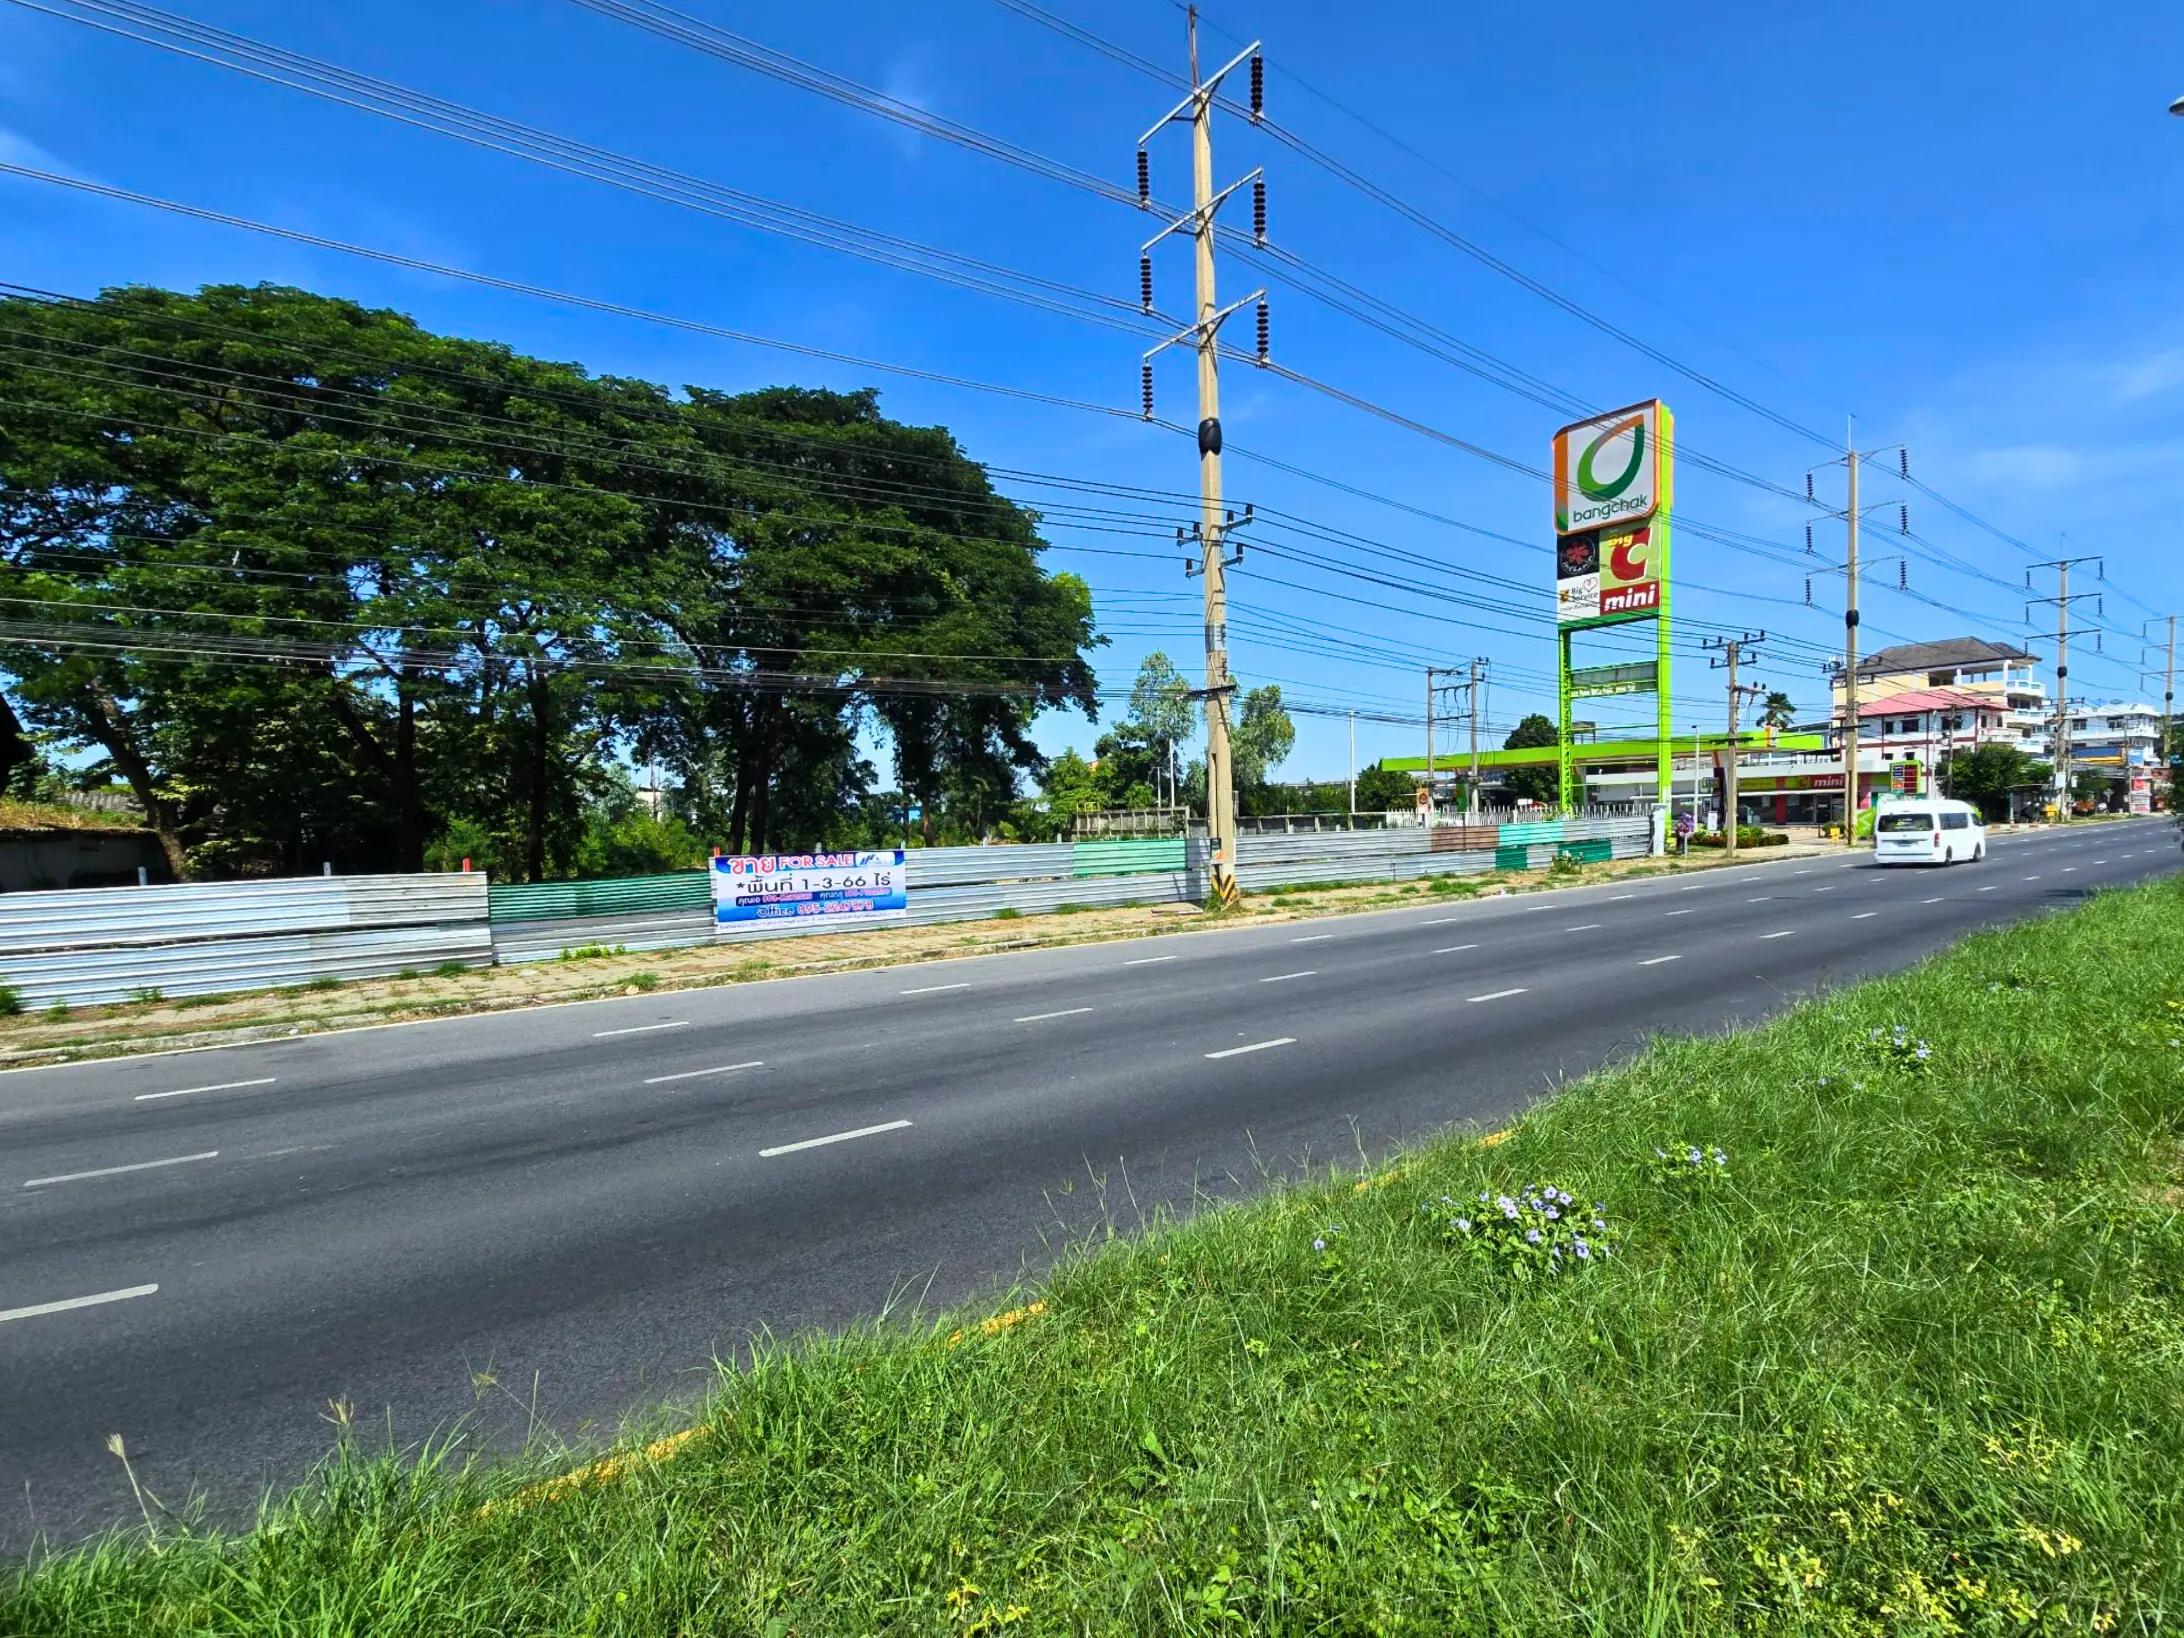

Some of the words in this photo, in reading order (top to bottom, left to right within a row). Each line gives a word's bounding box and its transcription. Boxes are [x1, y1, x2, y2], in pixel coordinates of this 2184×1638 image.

[1573, 494, 1648, 522] bangchak
[1604, 584, 1656, 611] mini
[1814, 776, 1845, 787] mini
[729, 857, 776, 875] ขาย
[780, 857, 813, 870] FOR
[816, 854, 853, 867] SALE
[801, 876, 866, 890] 1-3-66
[873, 871, 891, 886] ไร่
